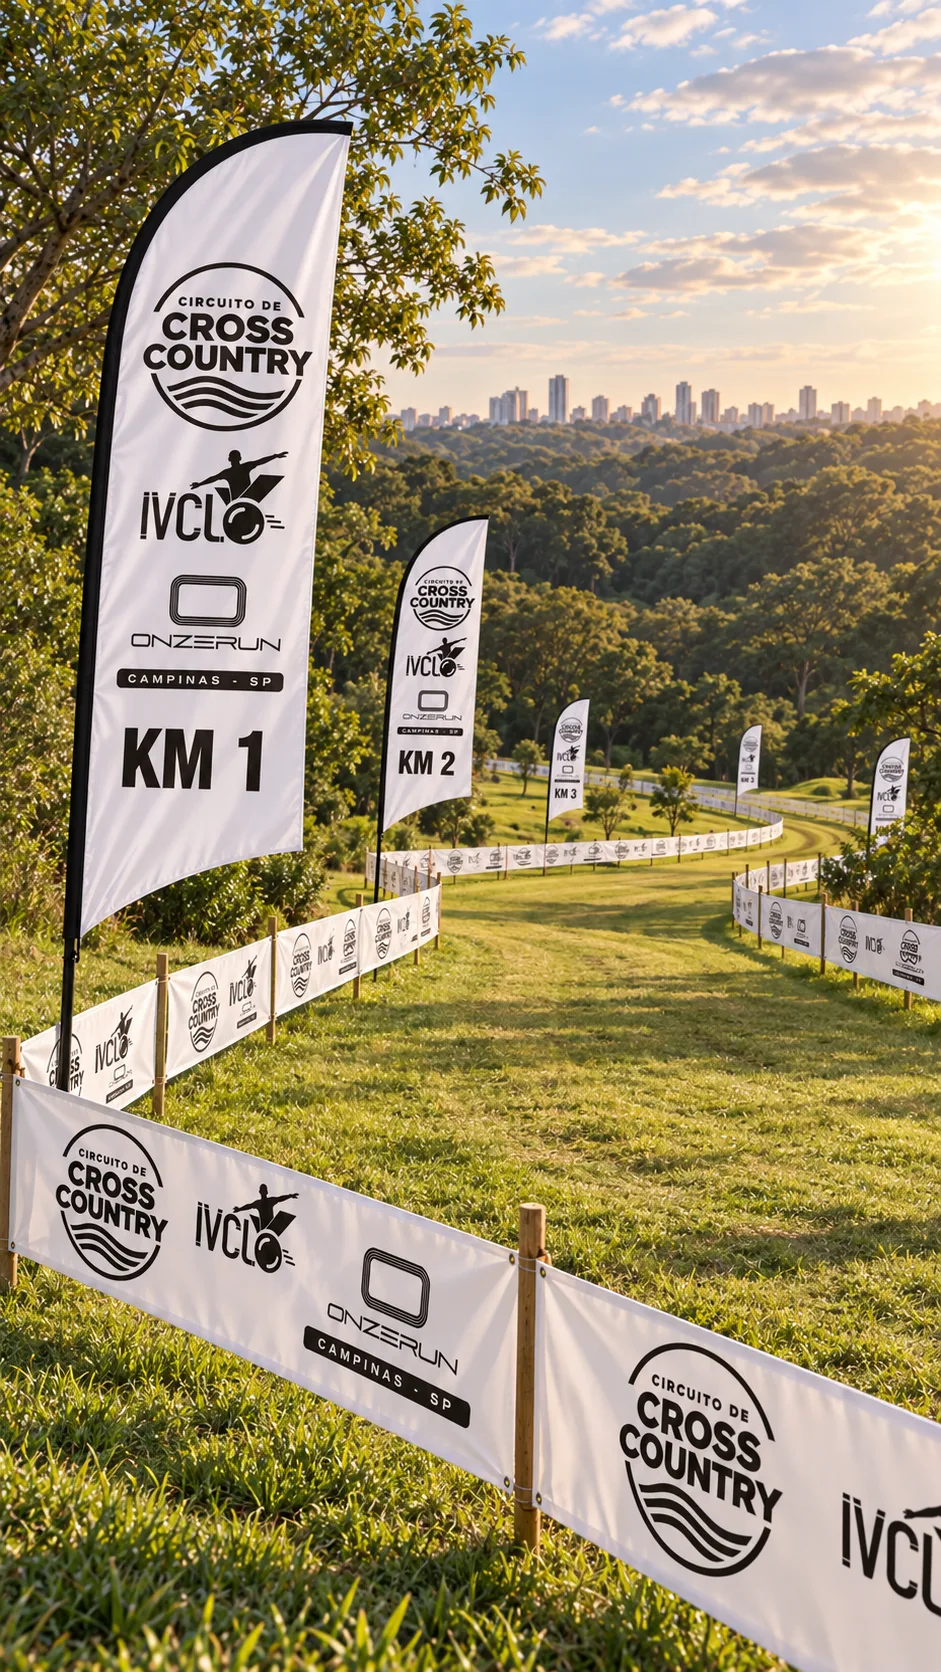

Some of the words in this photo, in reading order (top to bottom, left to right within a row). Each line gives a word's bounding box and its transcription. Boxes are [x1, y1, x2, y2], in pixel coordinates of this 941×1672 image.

[178, 296, 254, 310] CIRCUITO
[262, 300, 282, 311] DE
[162, 312, 294, 345] CROSS
[144, 343, 313, 376] COUNTRY
[410, 597, 475, 608] COUNTRY
[418, 586, 468, 597] CROSS
[131, 633, 281, 652] ONZERUN
[128, 674, 220, 685] CAMPINAS
[250, 676, 272, 687] SP
[122, 728, 214, 790] KM
[238, 730, 263, 792] 1
[398, 750, 433, 775] KM
[440, 751, 455, 776] 2
[555, 788, 568, 798] KM
[570, 789, 577, 799] 3
[192, 992, 216, 1014] CROSS
[79, 1149, 128, 1170] CIRCUITO
[132, 1165, 146, 1177] DE
[68, 1161, 155, 1210] CROSS
[56, 1184, 168, 1242] COUNTRY
[327, 1302, 458, 1376] ONZERUN
[318, 1338, 402, 1387] CAMPINAS
[430, 1393, 451, 1410] SP
[652, 1374, 722, 1411] CIRCUITO
[730, 1404, 749, 1423] DE
[637, 1392, 761, 1472] CROSS
[620, 1423, 783, 1523] COUNTRY
